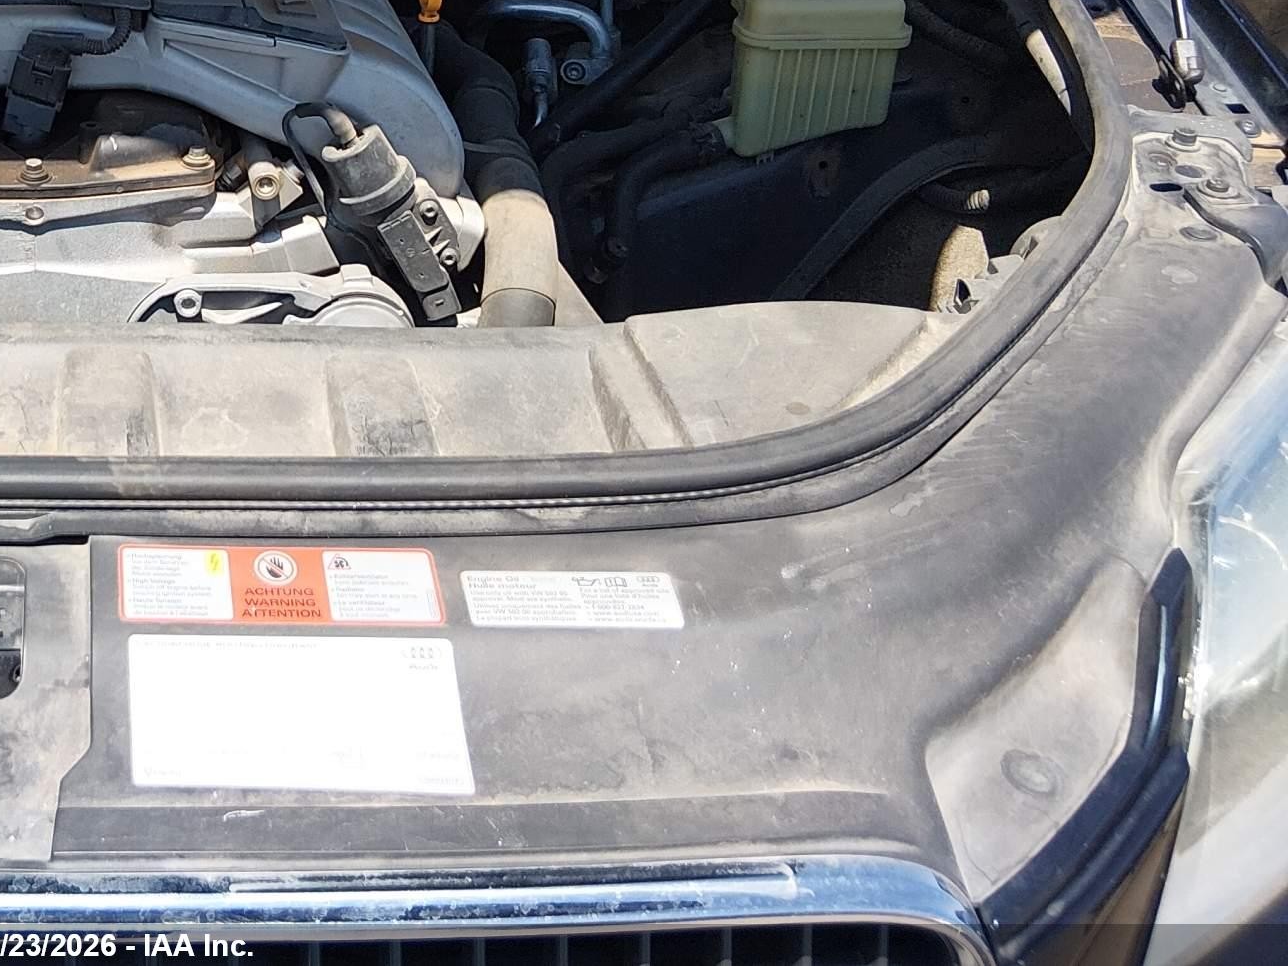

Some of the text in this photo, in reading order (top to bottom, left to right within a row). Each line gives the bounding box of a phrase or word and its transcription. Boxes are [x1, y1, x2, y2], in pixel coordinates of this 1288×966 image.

[245, 588, 314, 596] ACHTUNG
[244, 598, 316, 607] WARNING
[242, 609, 321, 618] ATTENTION
